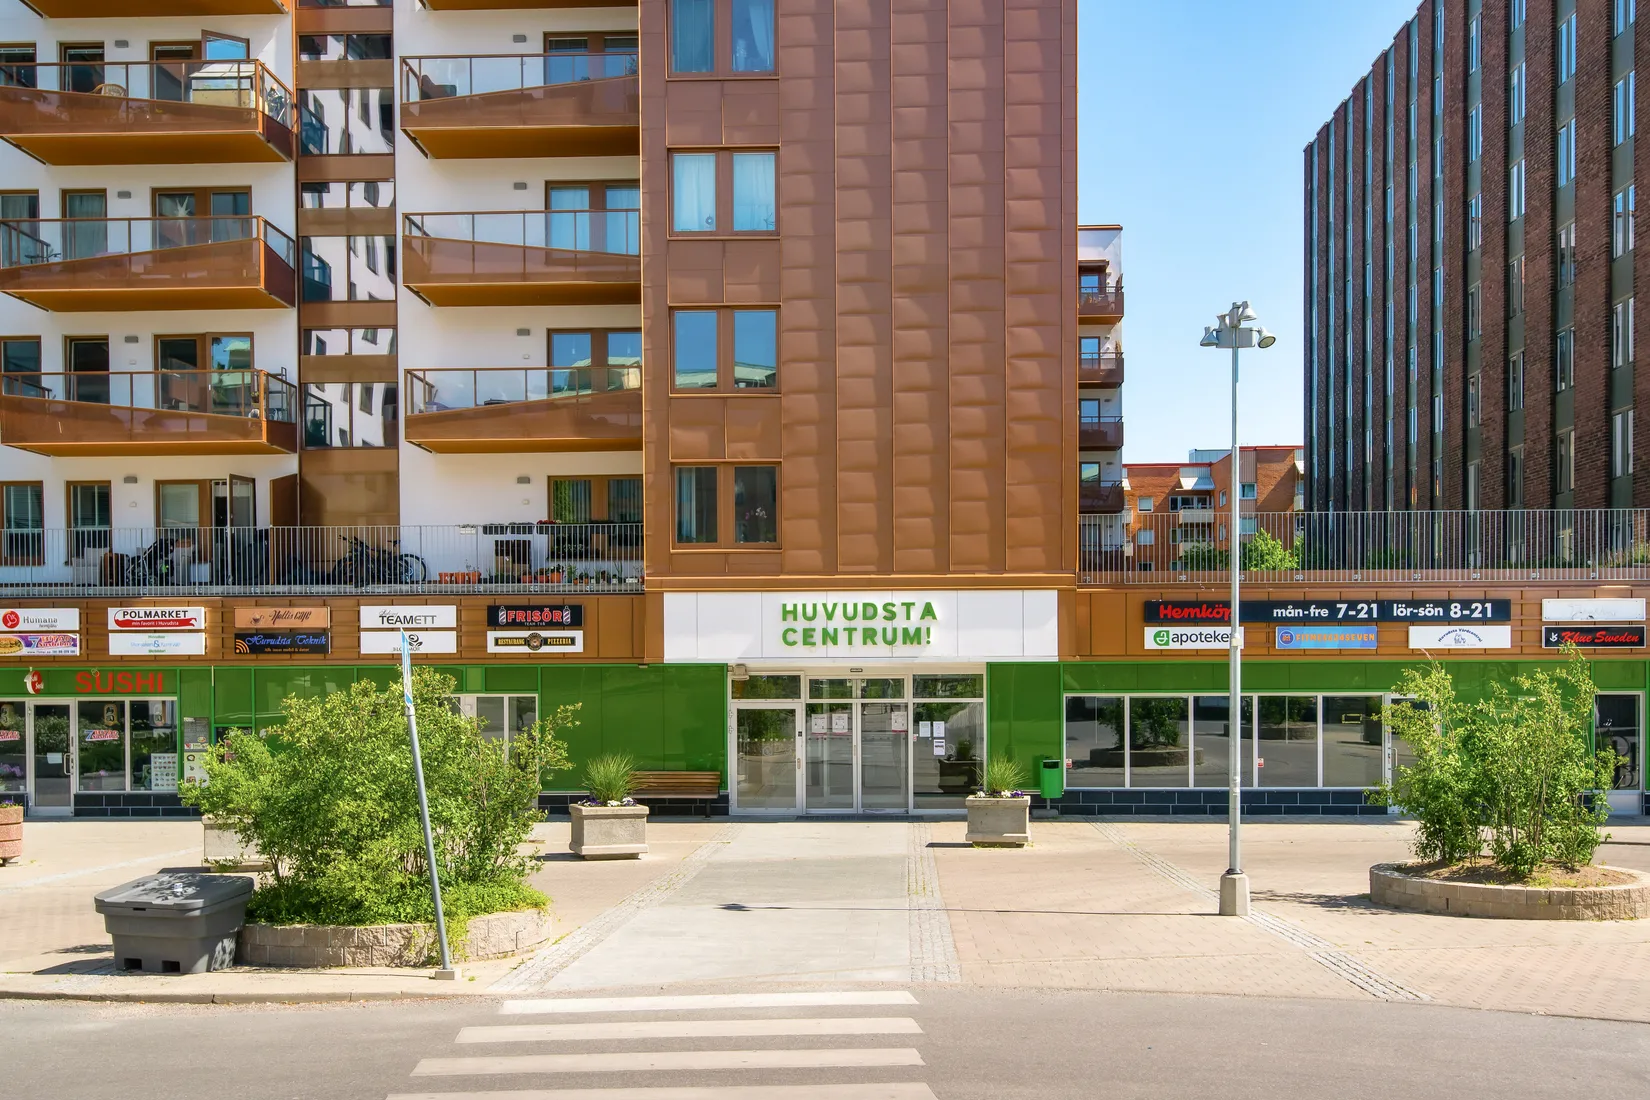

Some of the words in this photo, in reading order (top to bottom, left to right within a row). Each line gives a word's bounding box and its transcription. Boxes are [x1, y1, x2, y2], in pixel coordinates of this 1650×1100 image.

[122, 610, 189, 619] POLMARKET
[507, 607, 563, 622] FRISÖR
[781, 602, 938, 622] HUVUDSTA
[1273, 605, 1329, 618] mån-fre
[1336, 603, 1378, 619] 7-21
[1393, 603, 1443, 617] lör-sön
[1450, 602, 1492, 618] 8-21
[23, 616, 58, 624] Humana
[245, 635, 292, 645] Huvudsta
[295, 635, 326, 645] Teknik
[781, 627, 932, 646] CENTRUM!
[1561, 631, 1593, 643] Khue
[1594, 631, 1640, 643] Sweden
[75, 671, 163, 693] SUSHI
